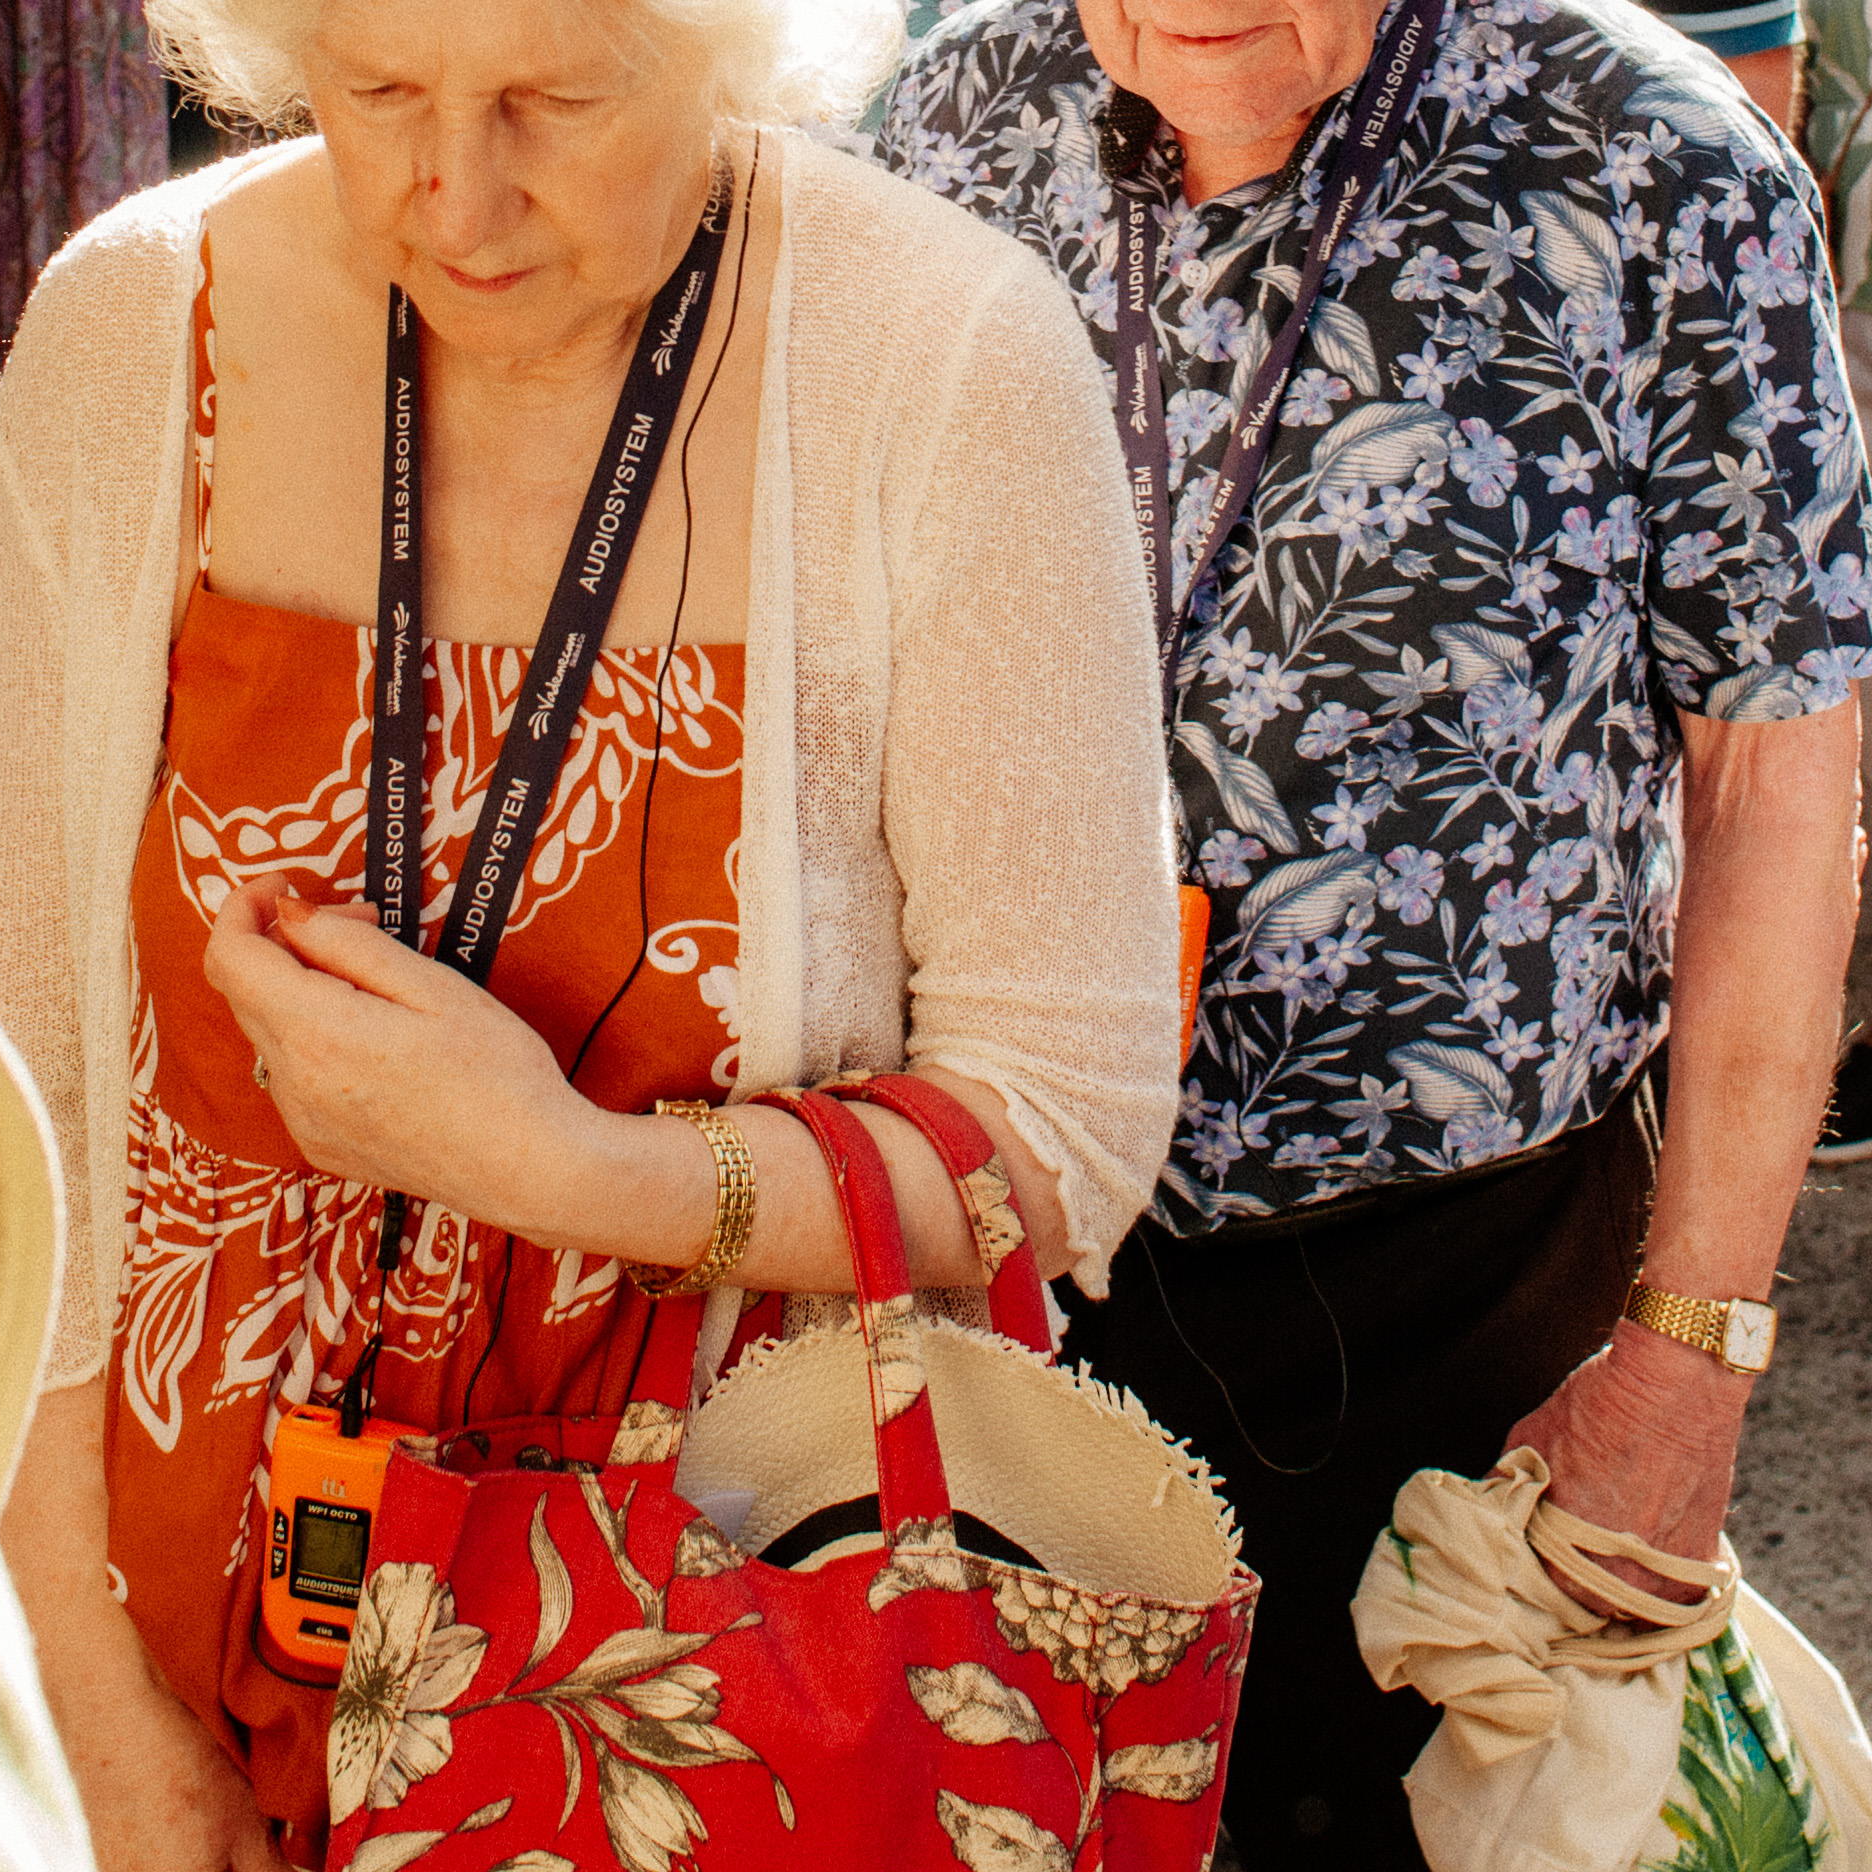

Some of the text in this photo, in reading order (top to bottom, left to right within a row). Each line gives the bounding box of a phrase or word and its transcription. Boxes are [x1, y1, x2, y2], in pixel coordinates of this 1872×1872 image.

[1359, 14, 1424, 149] AUDIOSYSTEM
[1129, 201, 1144, 312] AUDIOSYST
[660, 270, 701, 347] Vademecum
[393, 377, 412, 561] AUDIOSYSTEM
[578, 412, 655, 595] AUDIOSYSTEM
[393, 630, 411, 716] Vademecum
[535, 632, 579, 711] Vademecum
[456, 777, 531, 964] AUDIOSYSTEM
[330, 1509, 358, 1521] OCTO
[295, 1577, 361, 1597] AUDIOTOURS
